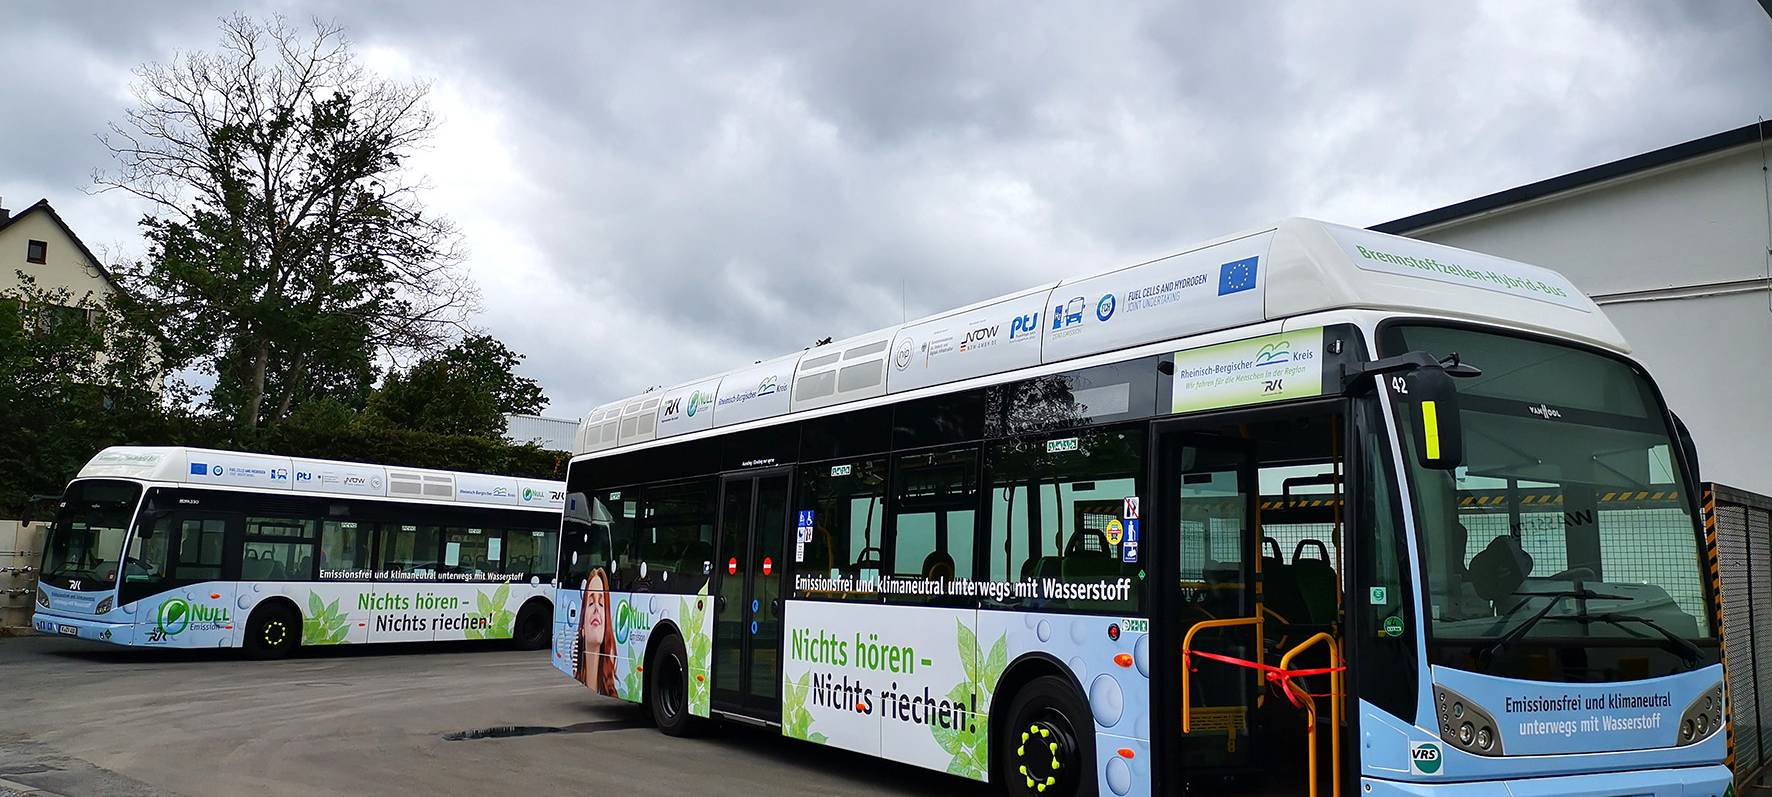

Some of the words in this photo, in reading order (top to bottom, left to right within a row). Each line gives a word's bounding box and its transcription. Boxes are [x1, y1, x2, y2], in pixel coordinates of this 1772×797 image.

[1356, 244, 1567, 298] Brennstoffzellen-Hybrid-Bus
[1128, 290, 1142, 300] FUEL
[1142, 285, 1161, 298] CELLS
[1161, 283, 1174, 294] AND
[1174, 274, 1208, 290] HYDROGEN
[1180, 360, 1254, 379] Rheinisch-Bergischer
[1292, 349, 1313, 361] Kreis
[1185, 381, 1195, 389] Wir
[1195, 379, 1214, 390] fahren
[1214, 377, 1224, 387] für
[1225, 375, 1234, 384] die
[1235, 372, 1264, 382] Menschen
[1272, 368, 1284, 377] der
[1284, 366, 1306, 376] Region
[1392, 377, 1408, 394] 42
[319, 569, 372, 579] Emissionsfrei
[374, 570, 389, 579] und
[390, 570, 436, 580] klimaneutral
[438, 572, 472, 582] unterwegs
[474, 571, 486, 580] mit
[487, 572, 524, 581] Wasserstoff
[795, 574, 853, 592] Emissionsfrei
[855, 576, 874, 593] und
[877, 576, 944, 595] klimaneutral
[947, 577, 1010, 601] unterwegs
[1015, 577, 1039, 597] mit
[1042, 578, 1131, 600] Wasserstoff
[191, 604, 230, 621] NULL
[358, 593, 409, 611] Nichts
[415, 592, 458, 609] hören
[190, 623, 220, 631] Emission
[376, 614, 426, 632] Nichts
[431, 613, 493, 631] riechen!
[630, 608, 650, 630] NULL
[792, 627, 848, 667] Nichts
[855, 632, 914, 674] hören
[813, 671, 872, 715] Nichts
[881, 681, 976, 735] riechen!
[1505, 694, 1581, 713] Emissionsfrei
[1585, 694, 1605, 710] und
[1608, 692, 1672, 709] klimaneutral
[1519, 719, 1577, 737] unterwegs
[1580, 716, 1599, 732] mit
[1602, 712, 1661, 731] Wasserstoff
[1412, 749, 1436, 760] VRS
